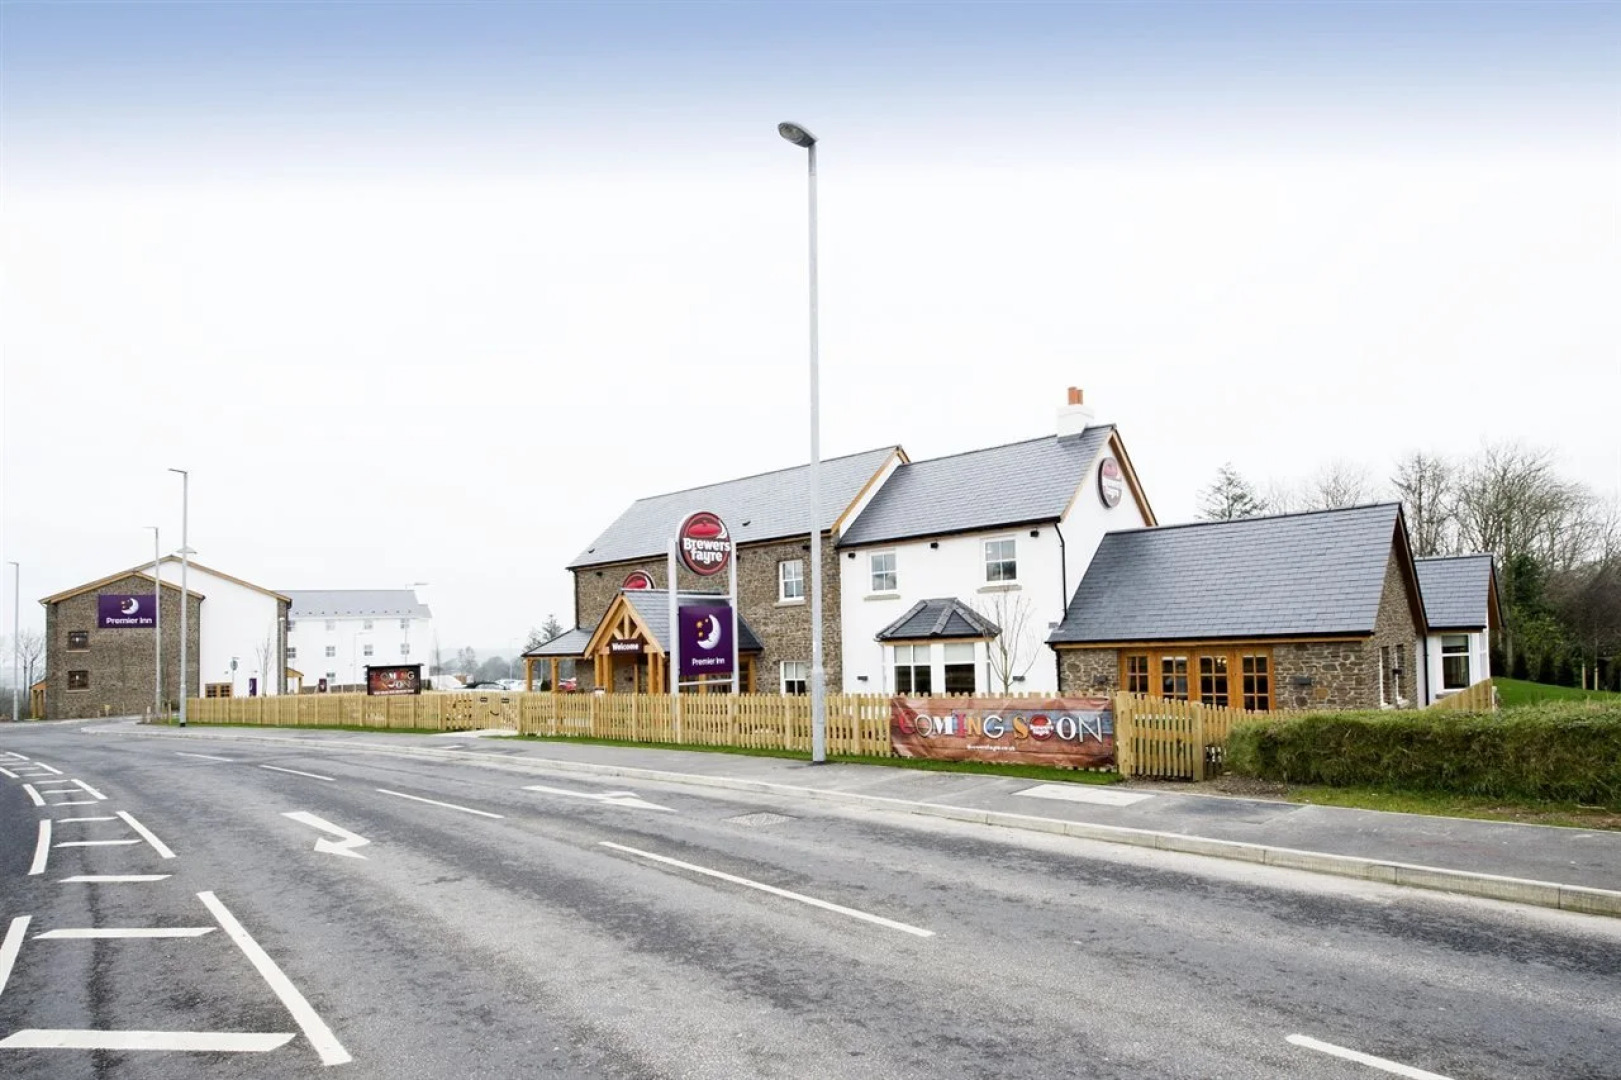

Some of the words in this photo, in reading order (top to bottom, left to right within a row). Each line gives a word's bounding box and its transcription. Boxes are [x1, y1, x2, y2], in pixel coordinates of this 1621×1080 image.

[683, 538, 731, 551] Brewers
[612, 643, 639, 651] Welcome
[692, 657, 715, 666] Premier
[716, 657, 725, 665] Inn
[898, 710, 1004, 739] COMING
[1012, 714, 1103, 743] SOON
